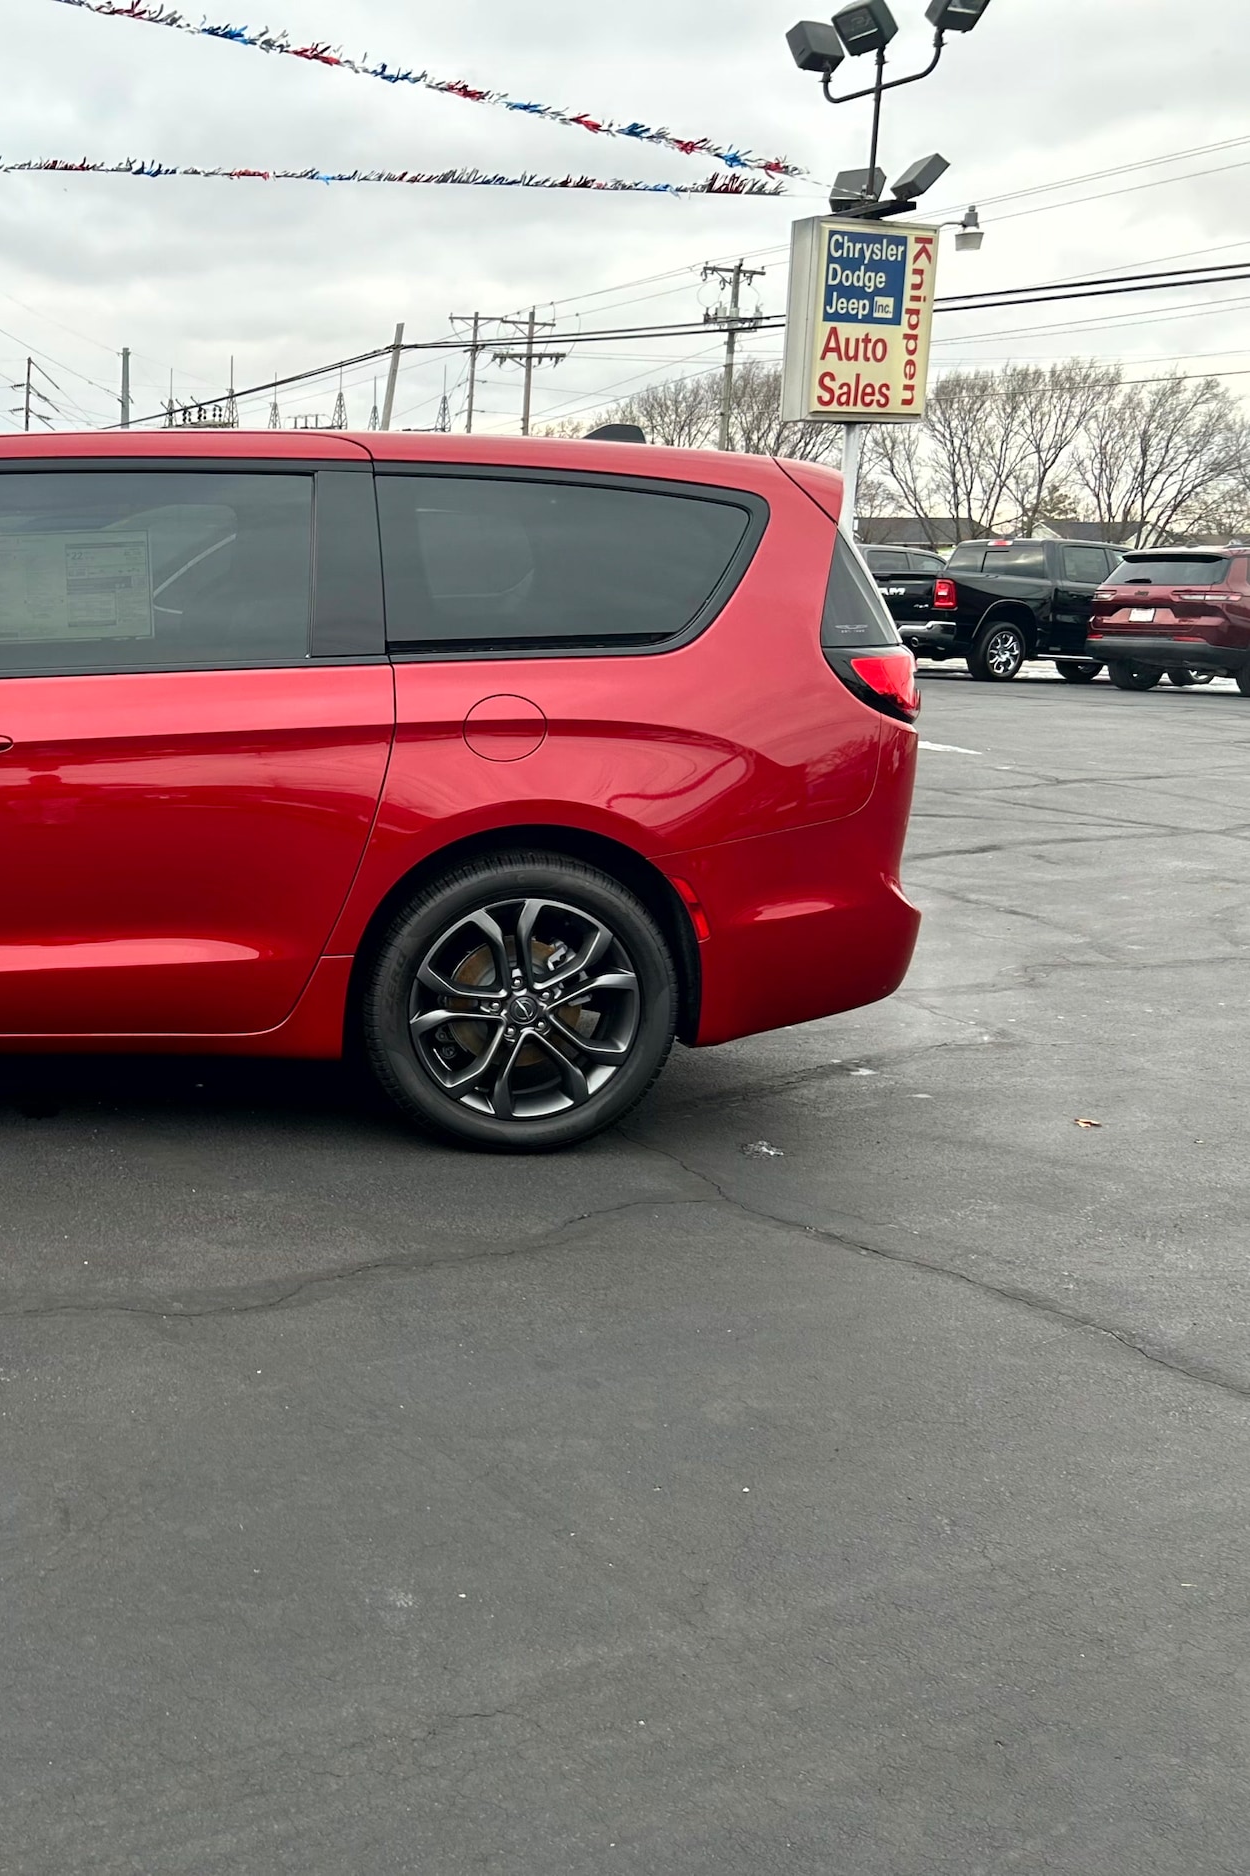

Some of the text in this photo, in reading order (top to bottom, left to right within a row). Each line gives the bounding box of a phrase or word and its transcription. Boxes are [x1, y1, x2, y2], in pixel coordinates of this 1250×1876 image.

[830, 234, 905, 263] Chrysler
[827, 263, 886, 292] Dodge
[826, 292, 892, 319] Jeep Inc.
[901, 236, 933, 406] Knippen
[819, 326, 888, 363] Auto
[816, 371, 891, 408] Sales
[877, 587, 906, 596] AM
